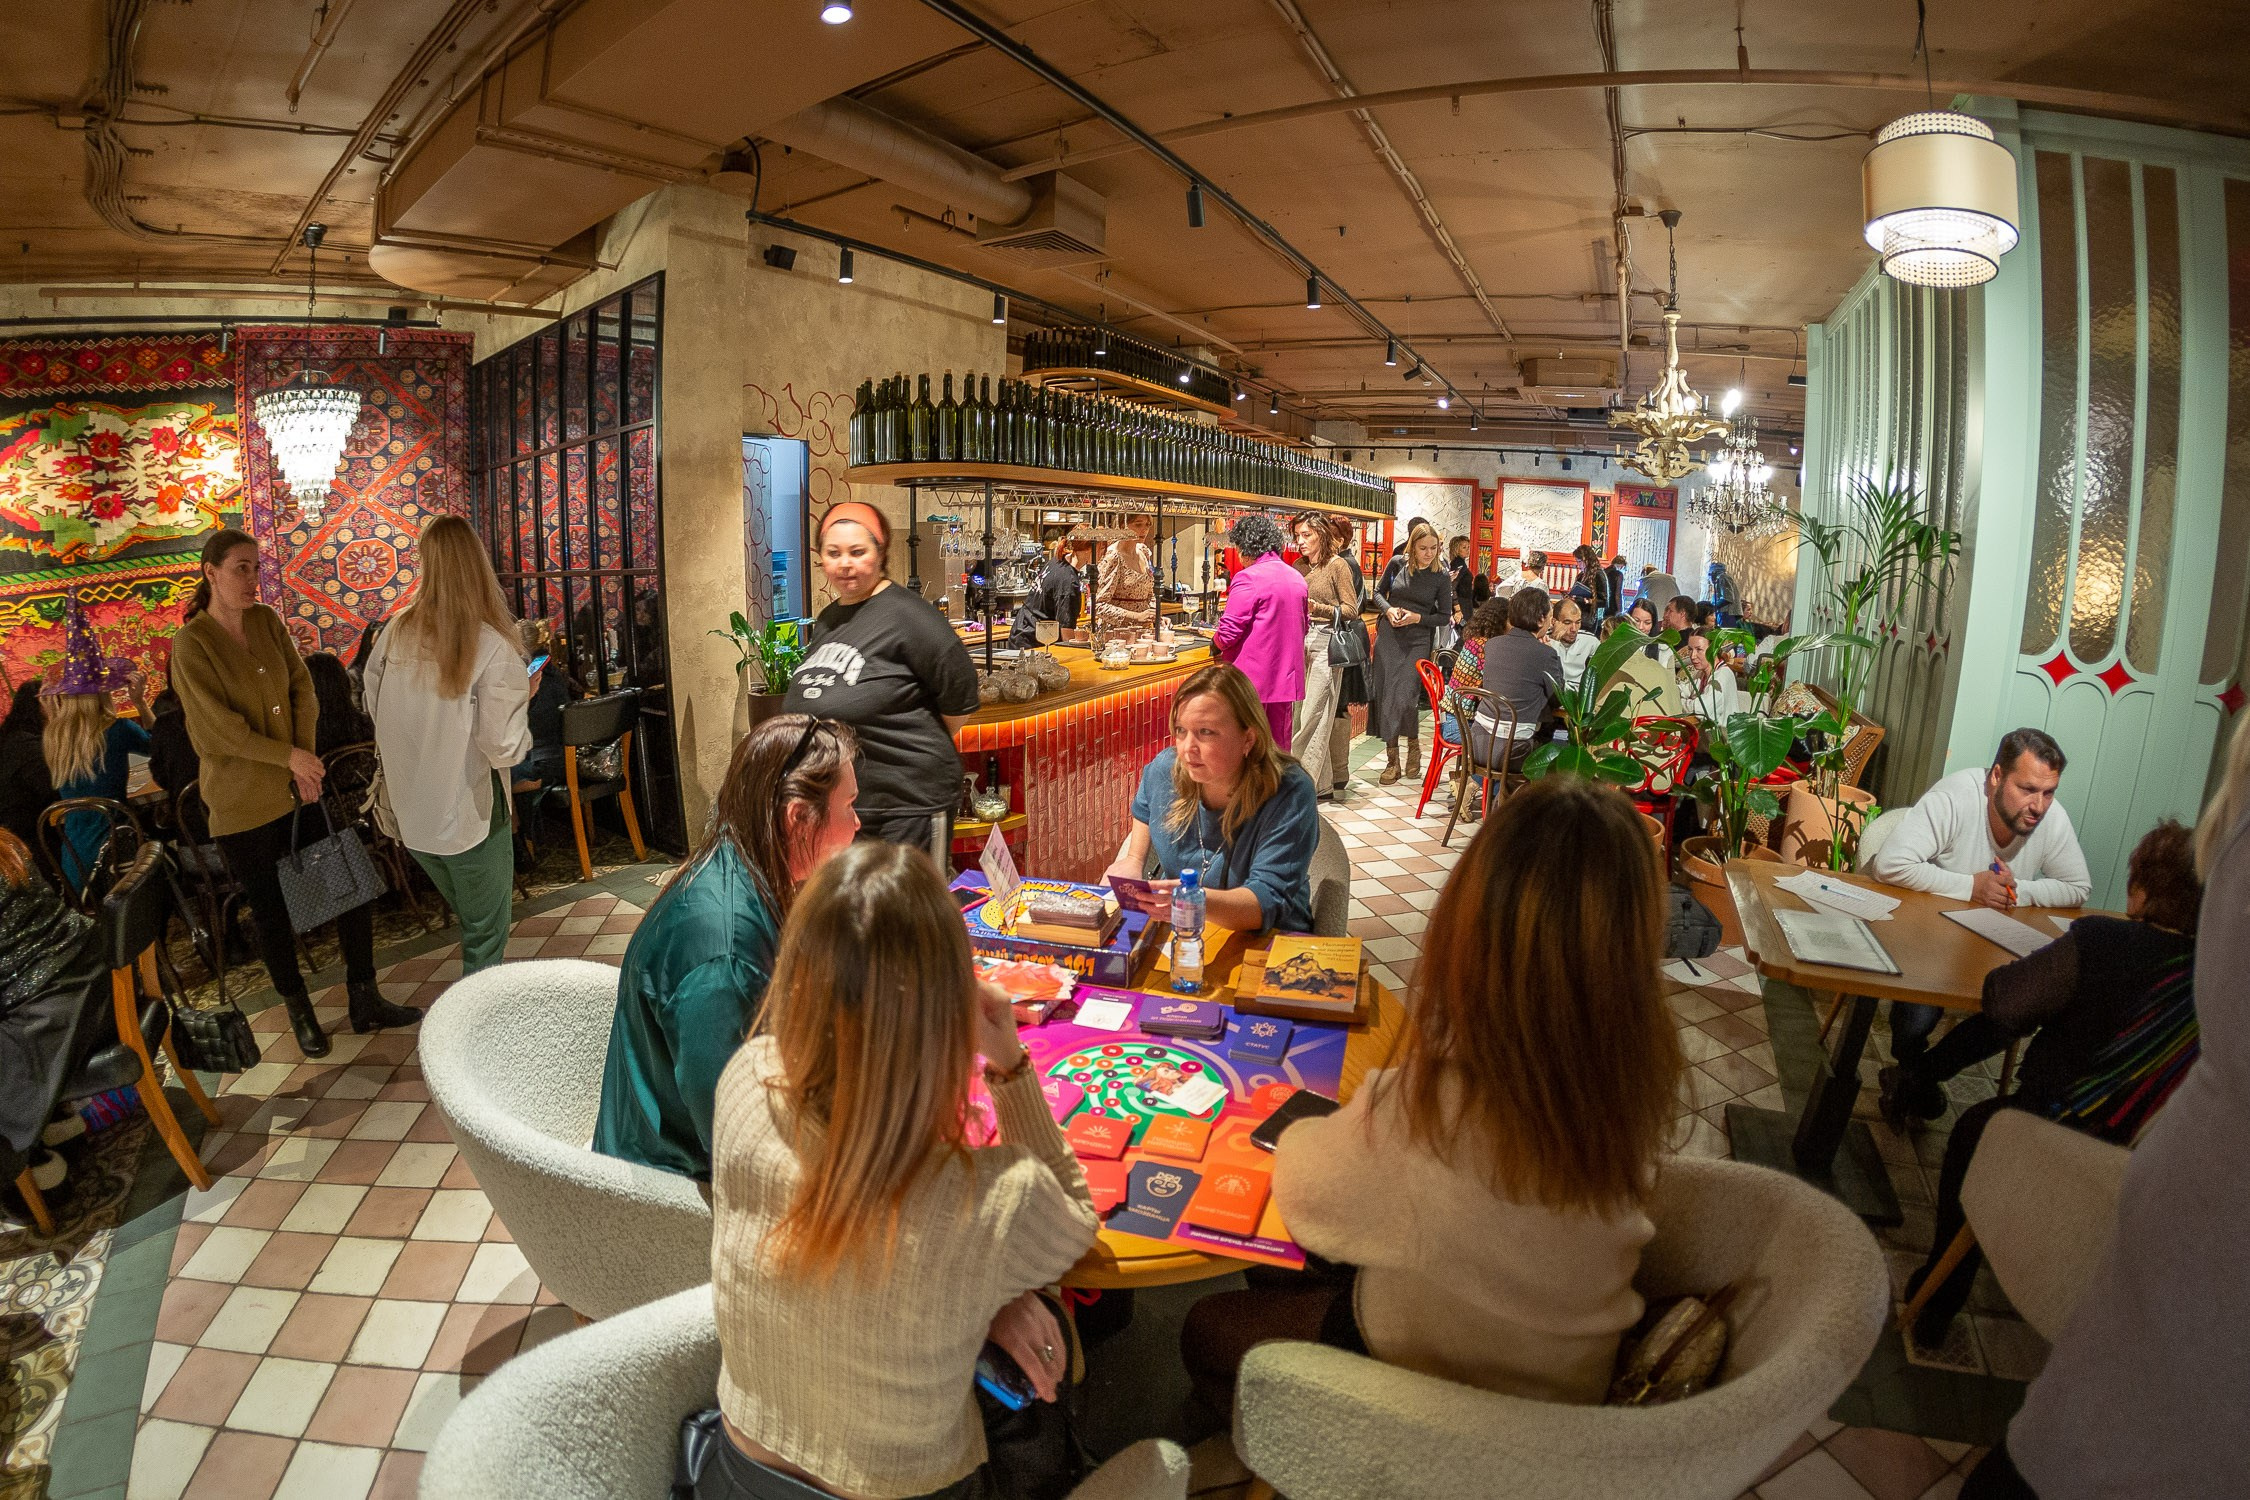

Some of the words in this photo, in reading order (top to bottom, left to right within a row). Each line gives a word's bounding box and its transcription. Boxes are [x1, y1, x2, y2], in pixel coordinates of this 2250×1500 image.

[1063, 953, 1096, 976] 101
[1245, 1041, 1270, 1050] СТАТУС
[1136, 1204, 1162, 1214] КАРТЫ
[1190, 1230, 1219, 1241] ЛИЧНЫЙ
